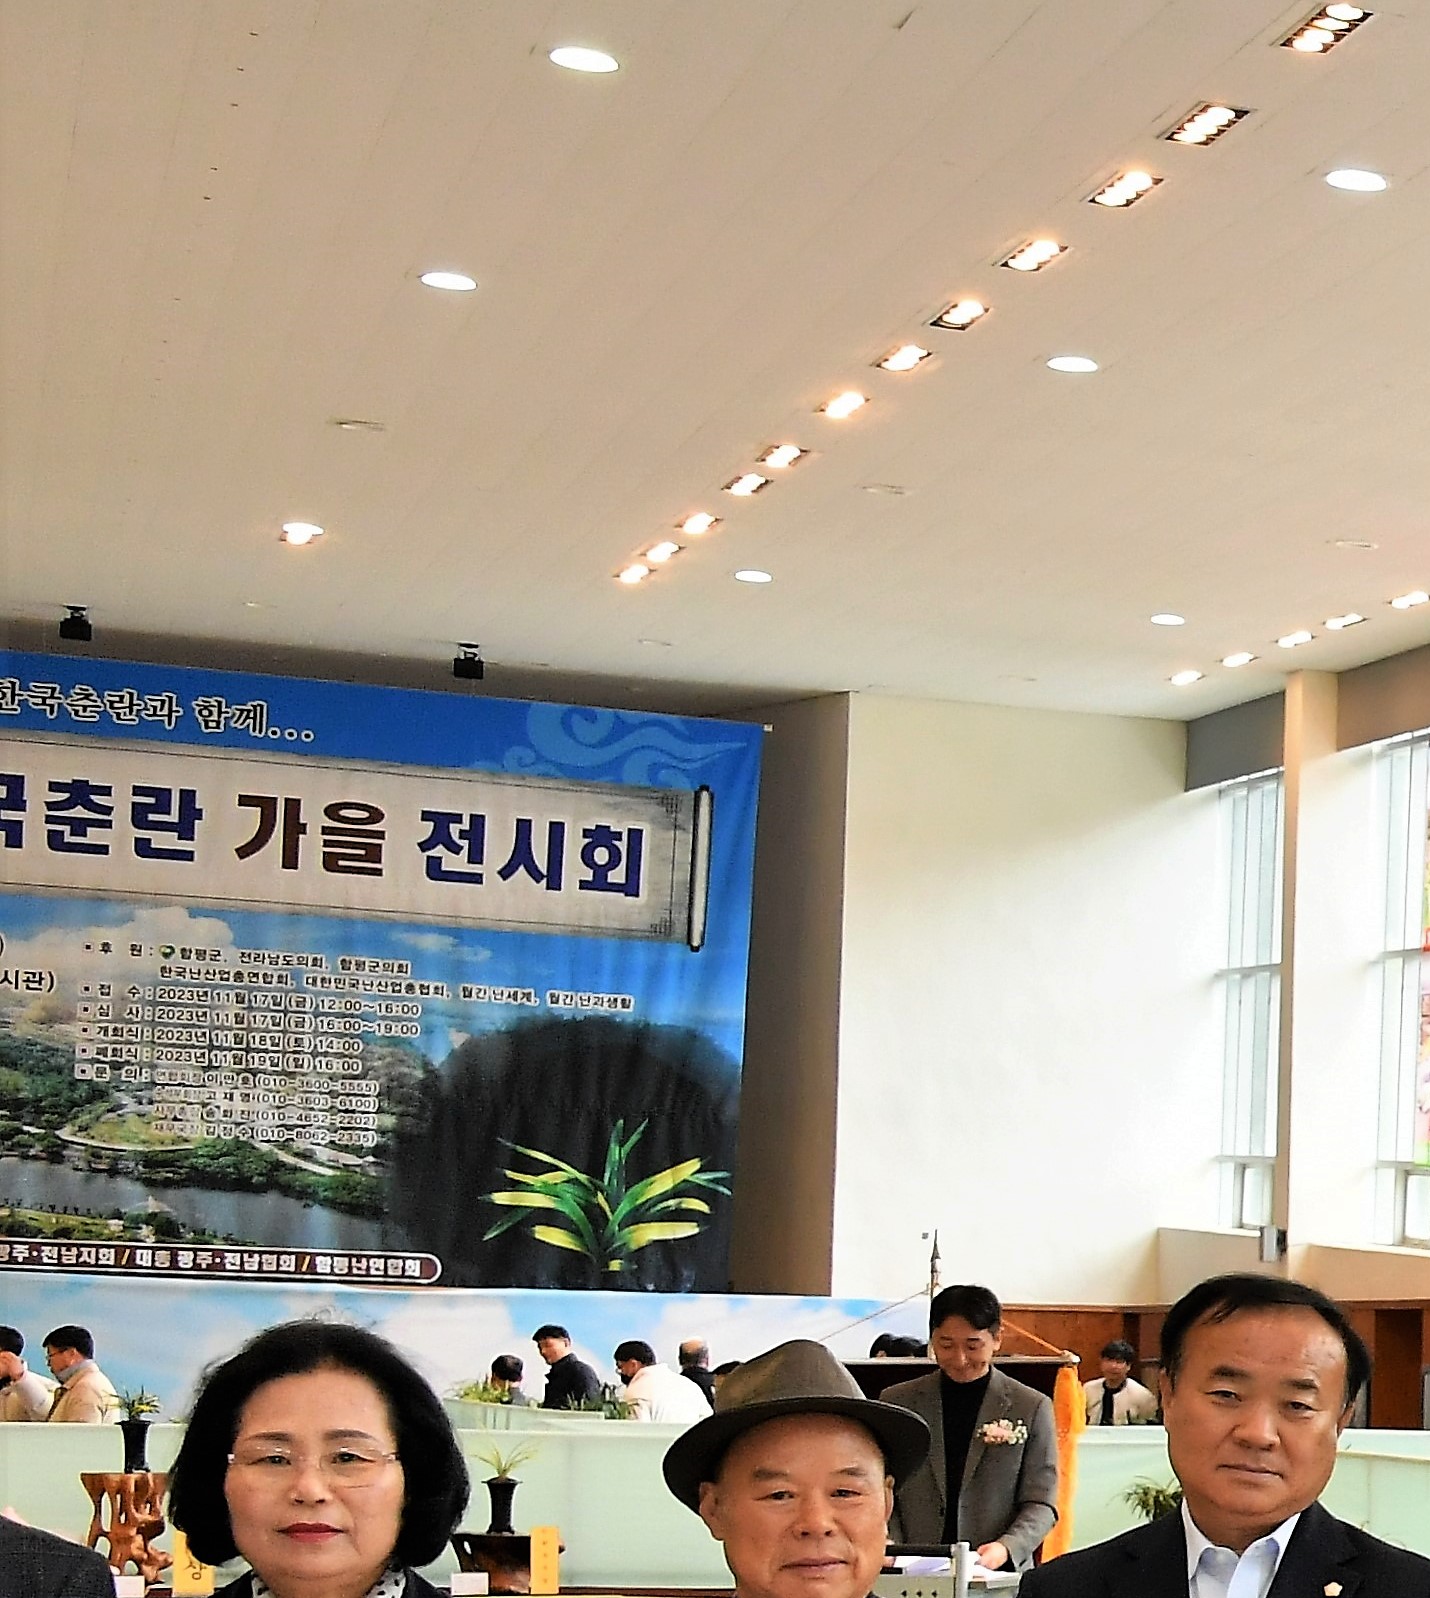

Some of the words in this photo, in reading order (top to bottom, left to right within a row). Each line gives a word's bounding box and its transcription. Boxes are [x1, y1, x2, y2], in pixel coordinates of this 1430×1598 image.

[234, 794, 386, 877] 가을
[417, 810, 644, 898] 전시회
[158, 988, 208, 1002] 2023년
[157, 1008, 208, 1022] 2023년
[156, 1029, 207, 1043] 2023년
[318, 1039, 360, 1051] 14:00
[156, 1050, 206, 1064] 2023년
[317, 1059, 360, 1072] 16:00
